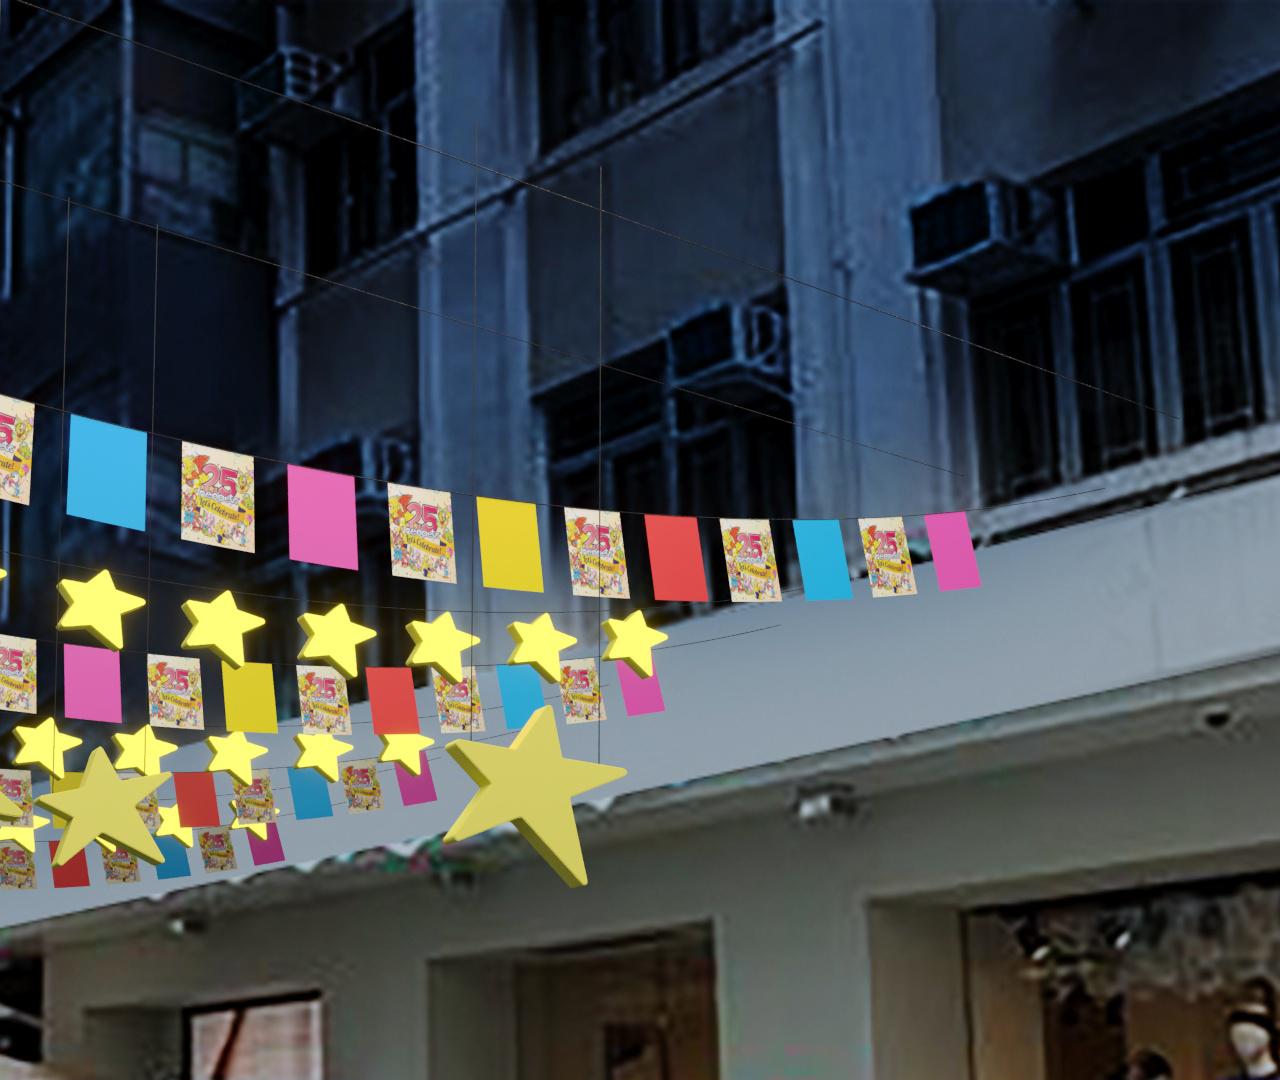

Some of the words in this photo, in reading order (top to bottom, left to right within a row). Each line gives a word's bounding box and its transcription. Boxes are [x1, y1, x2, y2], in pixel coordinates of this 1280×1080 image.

[200, 462, 237, 497] 25
[405, 501, 437, 532] 25
[580, 523, 610, 551] 25
[735, 532, 762, 558] 25
[872, 530, 898, 554] 25
[161, 667, 188, 691] 25
[310, 677, 335, 698] 25
[567, 669, 590, 689] 25
